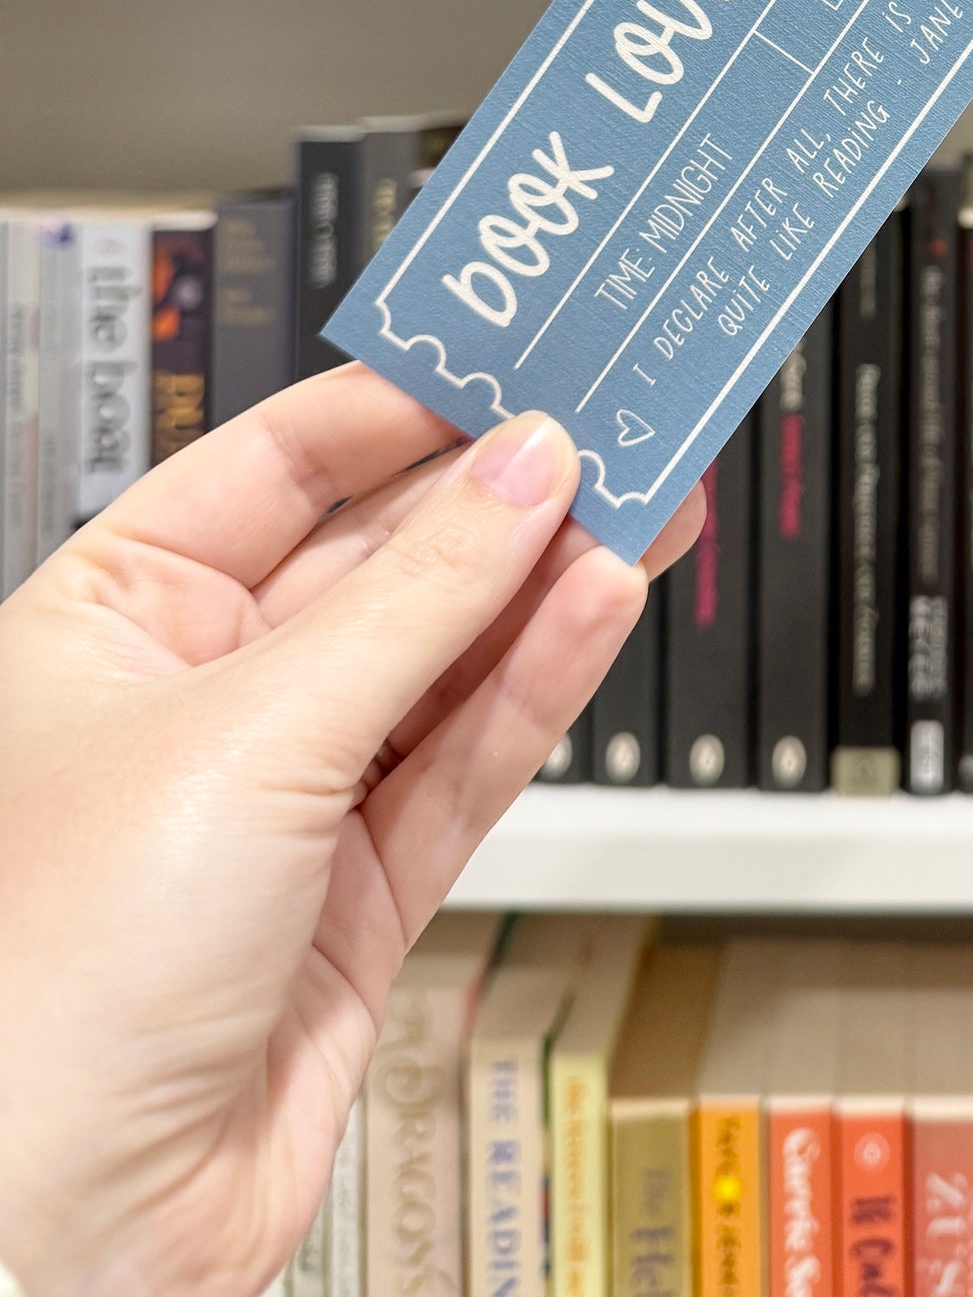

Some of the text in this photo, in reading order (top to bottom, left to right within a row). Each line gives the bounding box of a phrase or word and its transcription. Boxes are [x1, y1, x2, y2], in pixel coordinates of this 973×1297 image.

[595, 133, 732, 309] TIME: MIDNIGHT
[633, 364, 655, 385] I
[654, 257, 744, 359] DECLARE
[731, 178, 787, 252] AFTER
[787, 129, 831, 180] ALL,
[824, 37, 884, 115] THERE
[886, 2, 911, 32] IS
[718, 266, 769, 335] QUITE
[770, 203, 814, 260] LIKE
[813, 101, 890, 197] READING
[86, 265, 144, 475] the boat
[487, 1057, 522, 1126] THE
